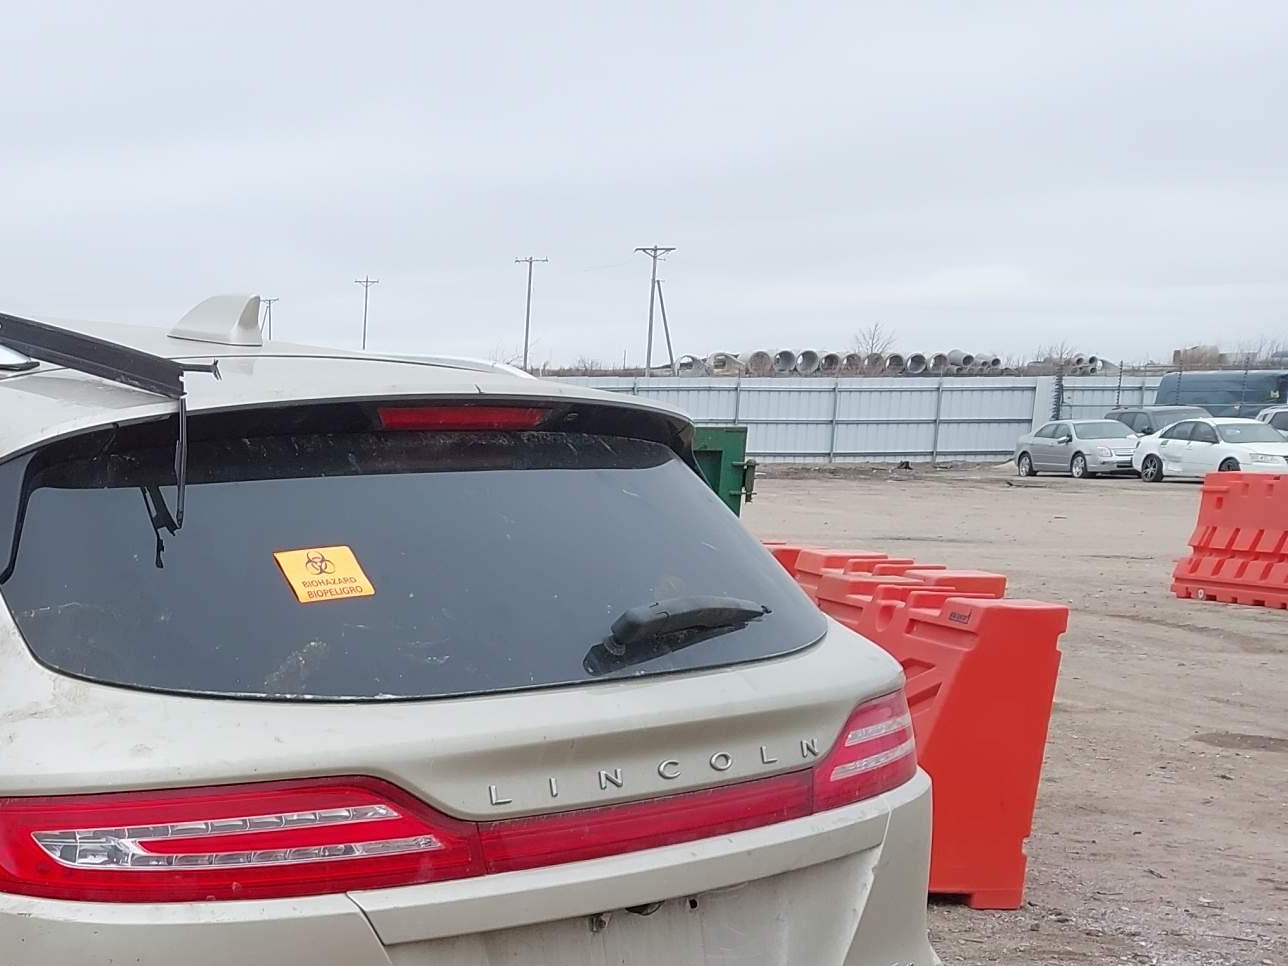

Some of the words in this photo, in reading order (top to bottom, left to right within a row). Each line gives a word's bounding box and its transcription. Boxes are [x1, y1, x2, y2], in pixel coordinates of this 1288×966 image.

[301, 576, 357, 589] BIOHAZARD
[306, 585, 364, 599] BIOPELIGRO
[488, 737, 819, 806] LINCOLN
